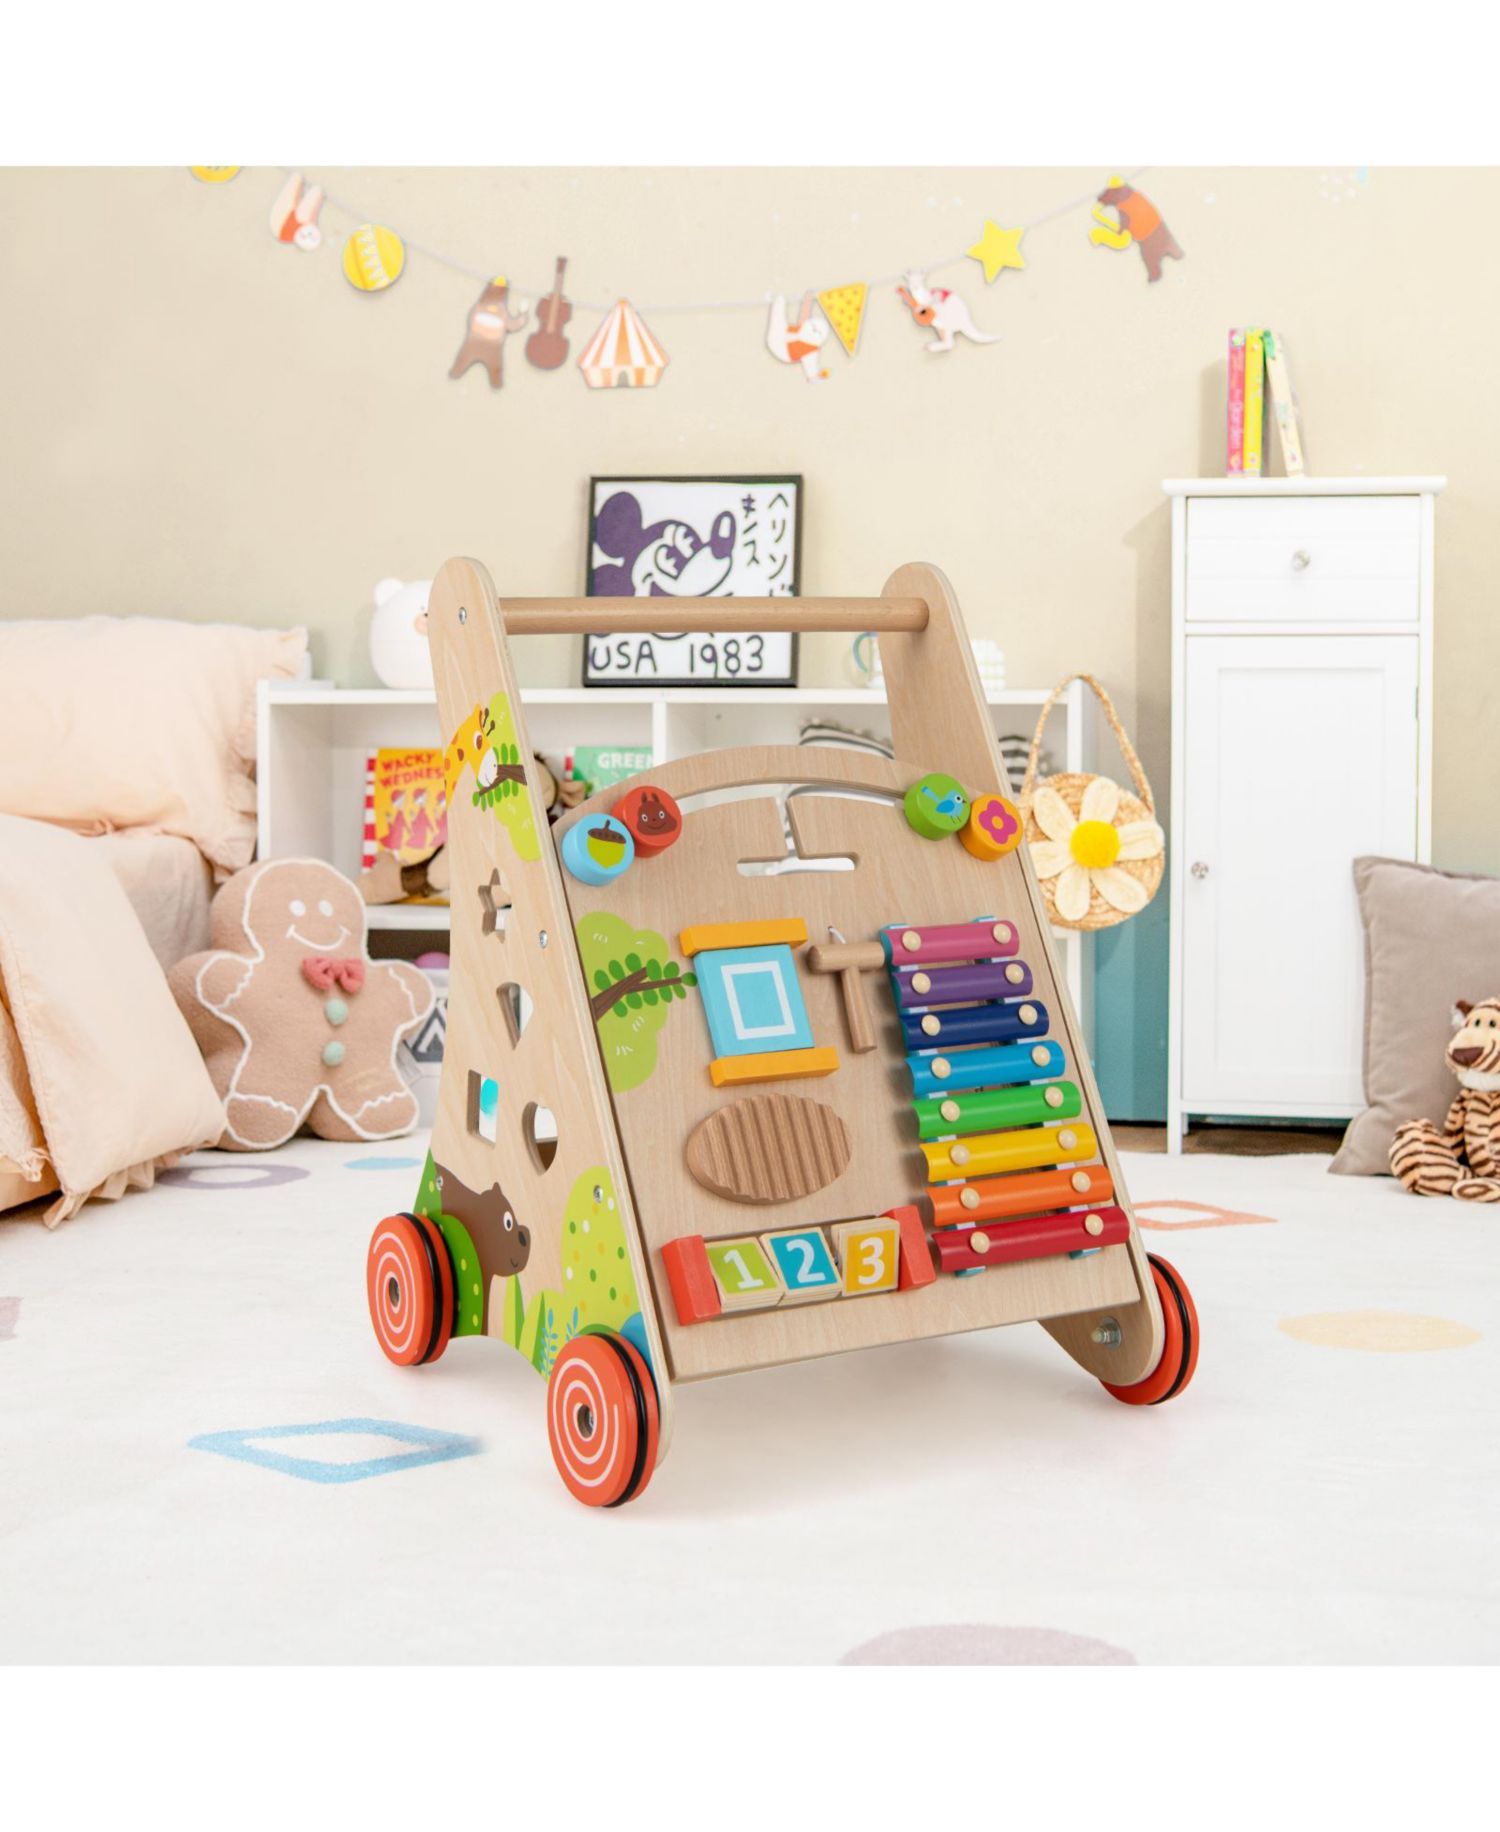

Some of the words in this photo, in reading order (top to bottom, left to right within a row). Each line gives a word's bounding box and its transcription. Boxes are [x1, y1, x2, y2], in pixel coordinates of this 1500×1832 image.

[591, 640, 657, 674] USA
[690, 634, 764, 678] 1983
[382, 752, 434, 772] WACKY
[723, 1250, 764, 1289] 1
[786, 1239, 826, 1283] 2
[857, 1237, 885, 1285] 3
